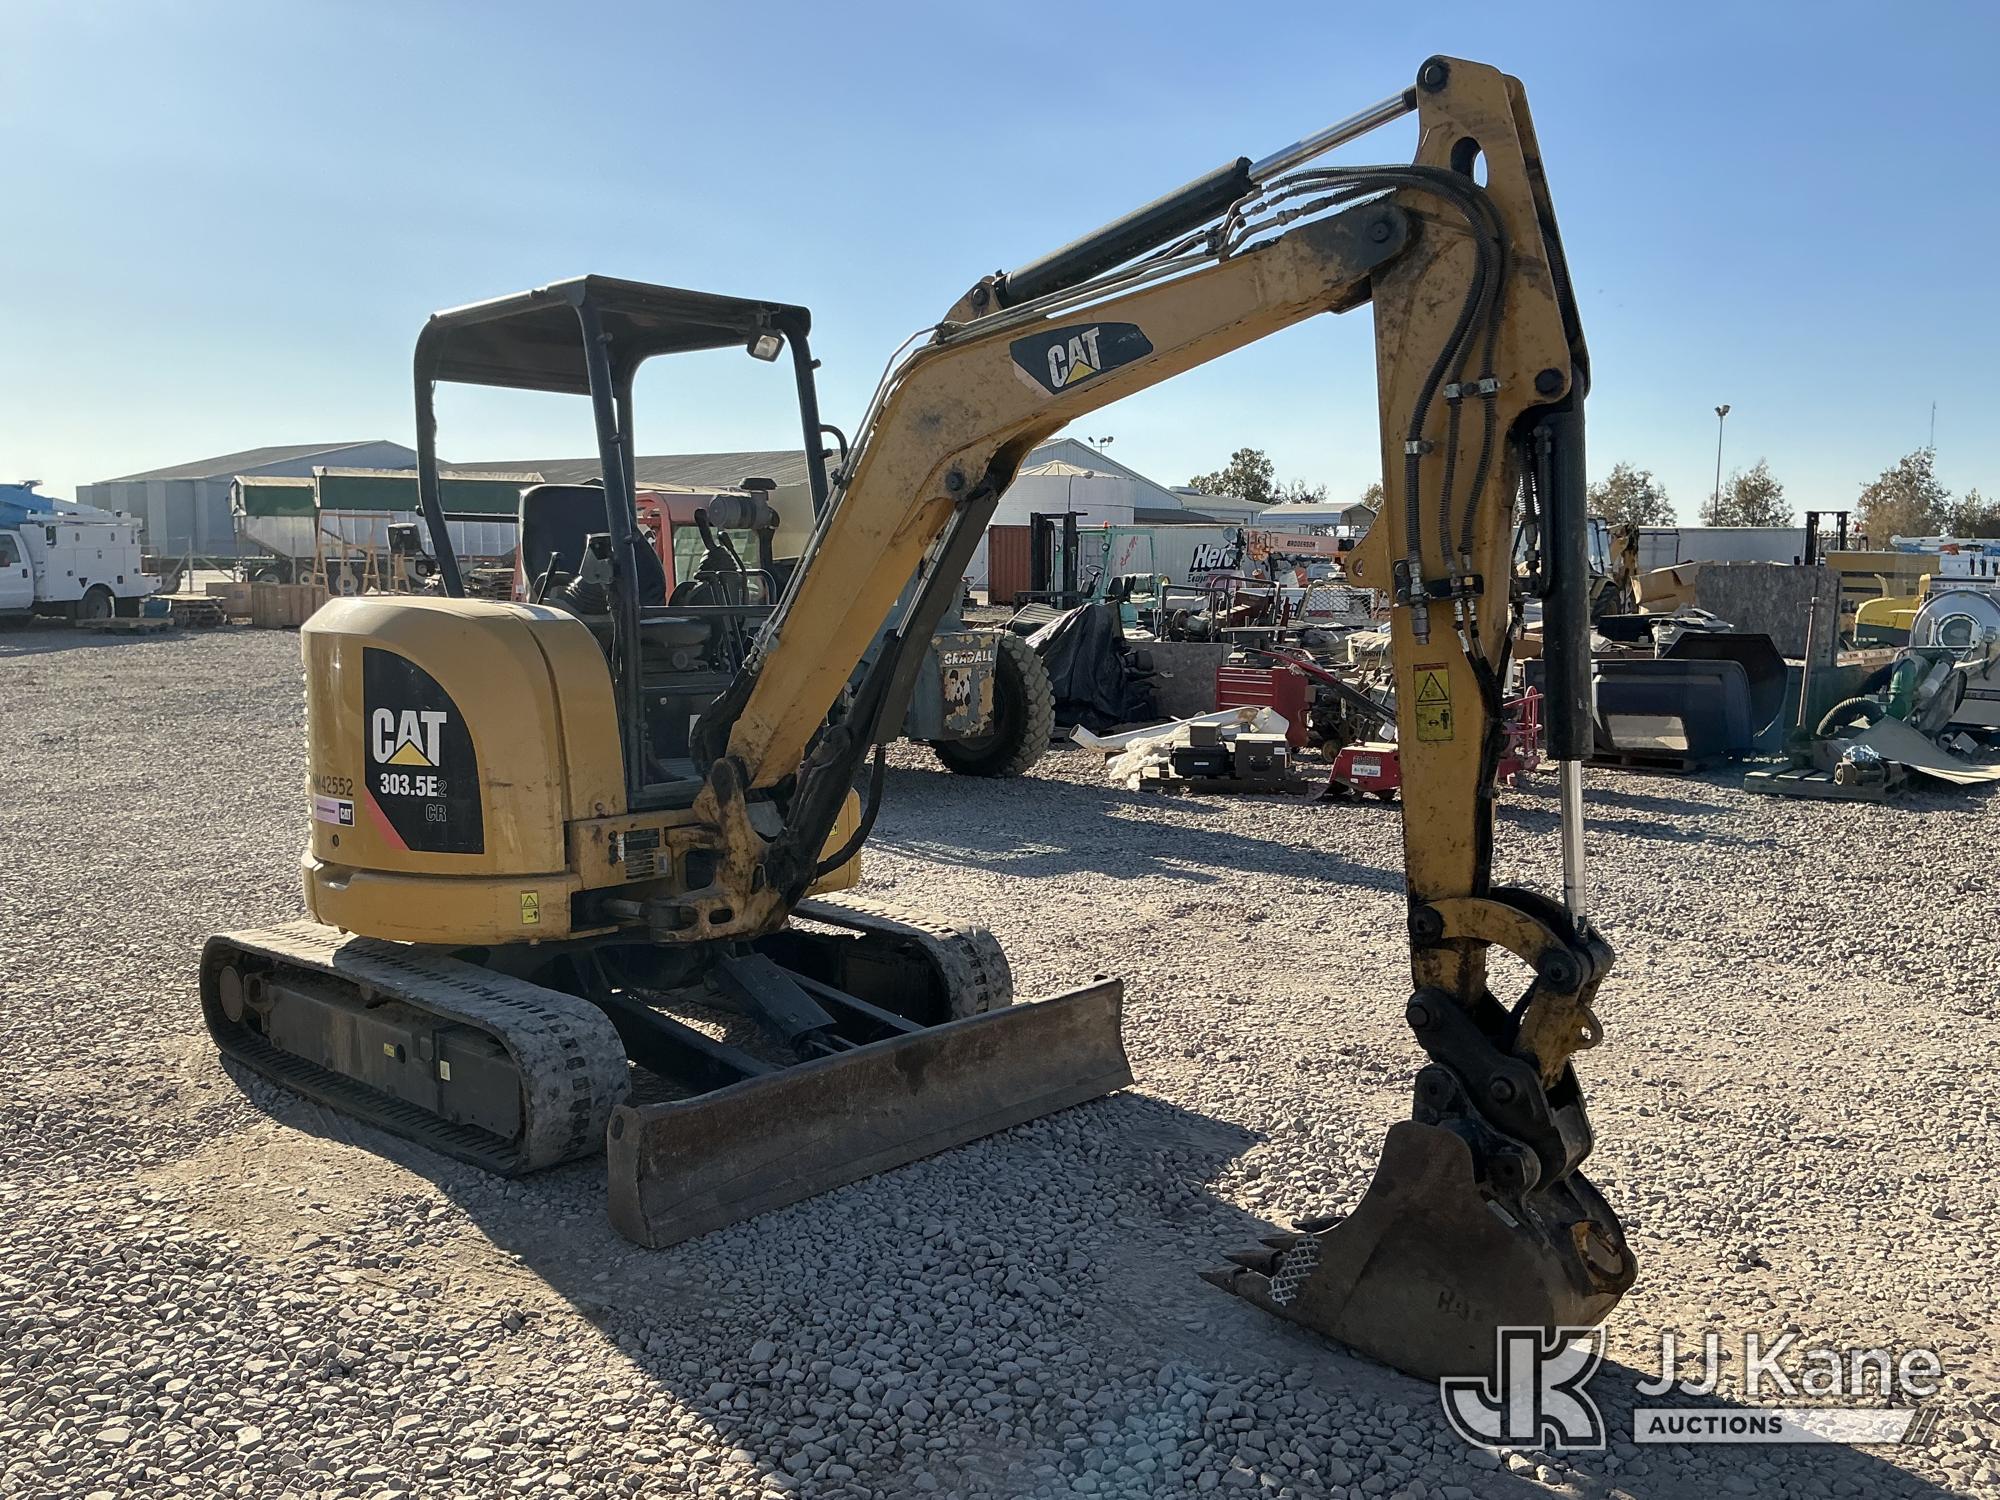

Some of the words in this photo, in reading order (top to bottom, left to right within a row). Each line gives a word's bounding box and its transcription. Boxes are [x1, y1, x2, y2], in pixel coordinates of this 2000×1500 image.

[1047, 326, 1102, 388] CAT
[944, 650, 994, 665] GRADALL
[372, 707, 447, 767] CAT
[380, 772, 448, 798] 303.5E2
[340, 807, 352, 820] CAT
[425, 803, 447, 822] CR
